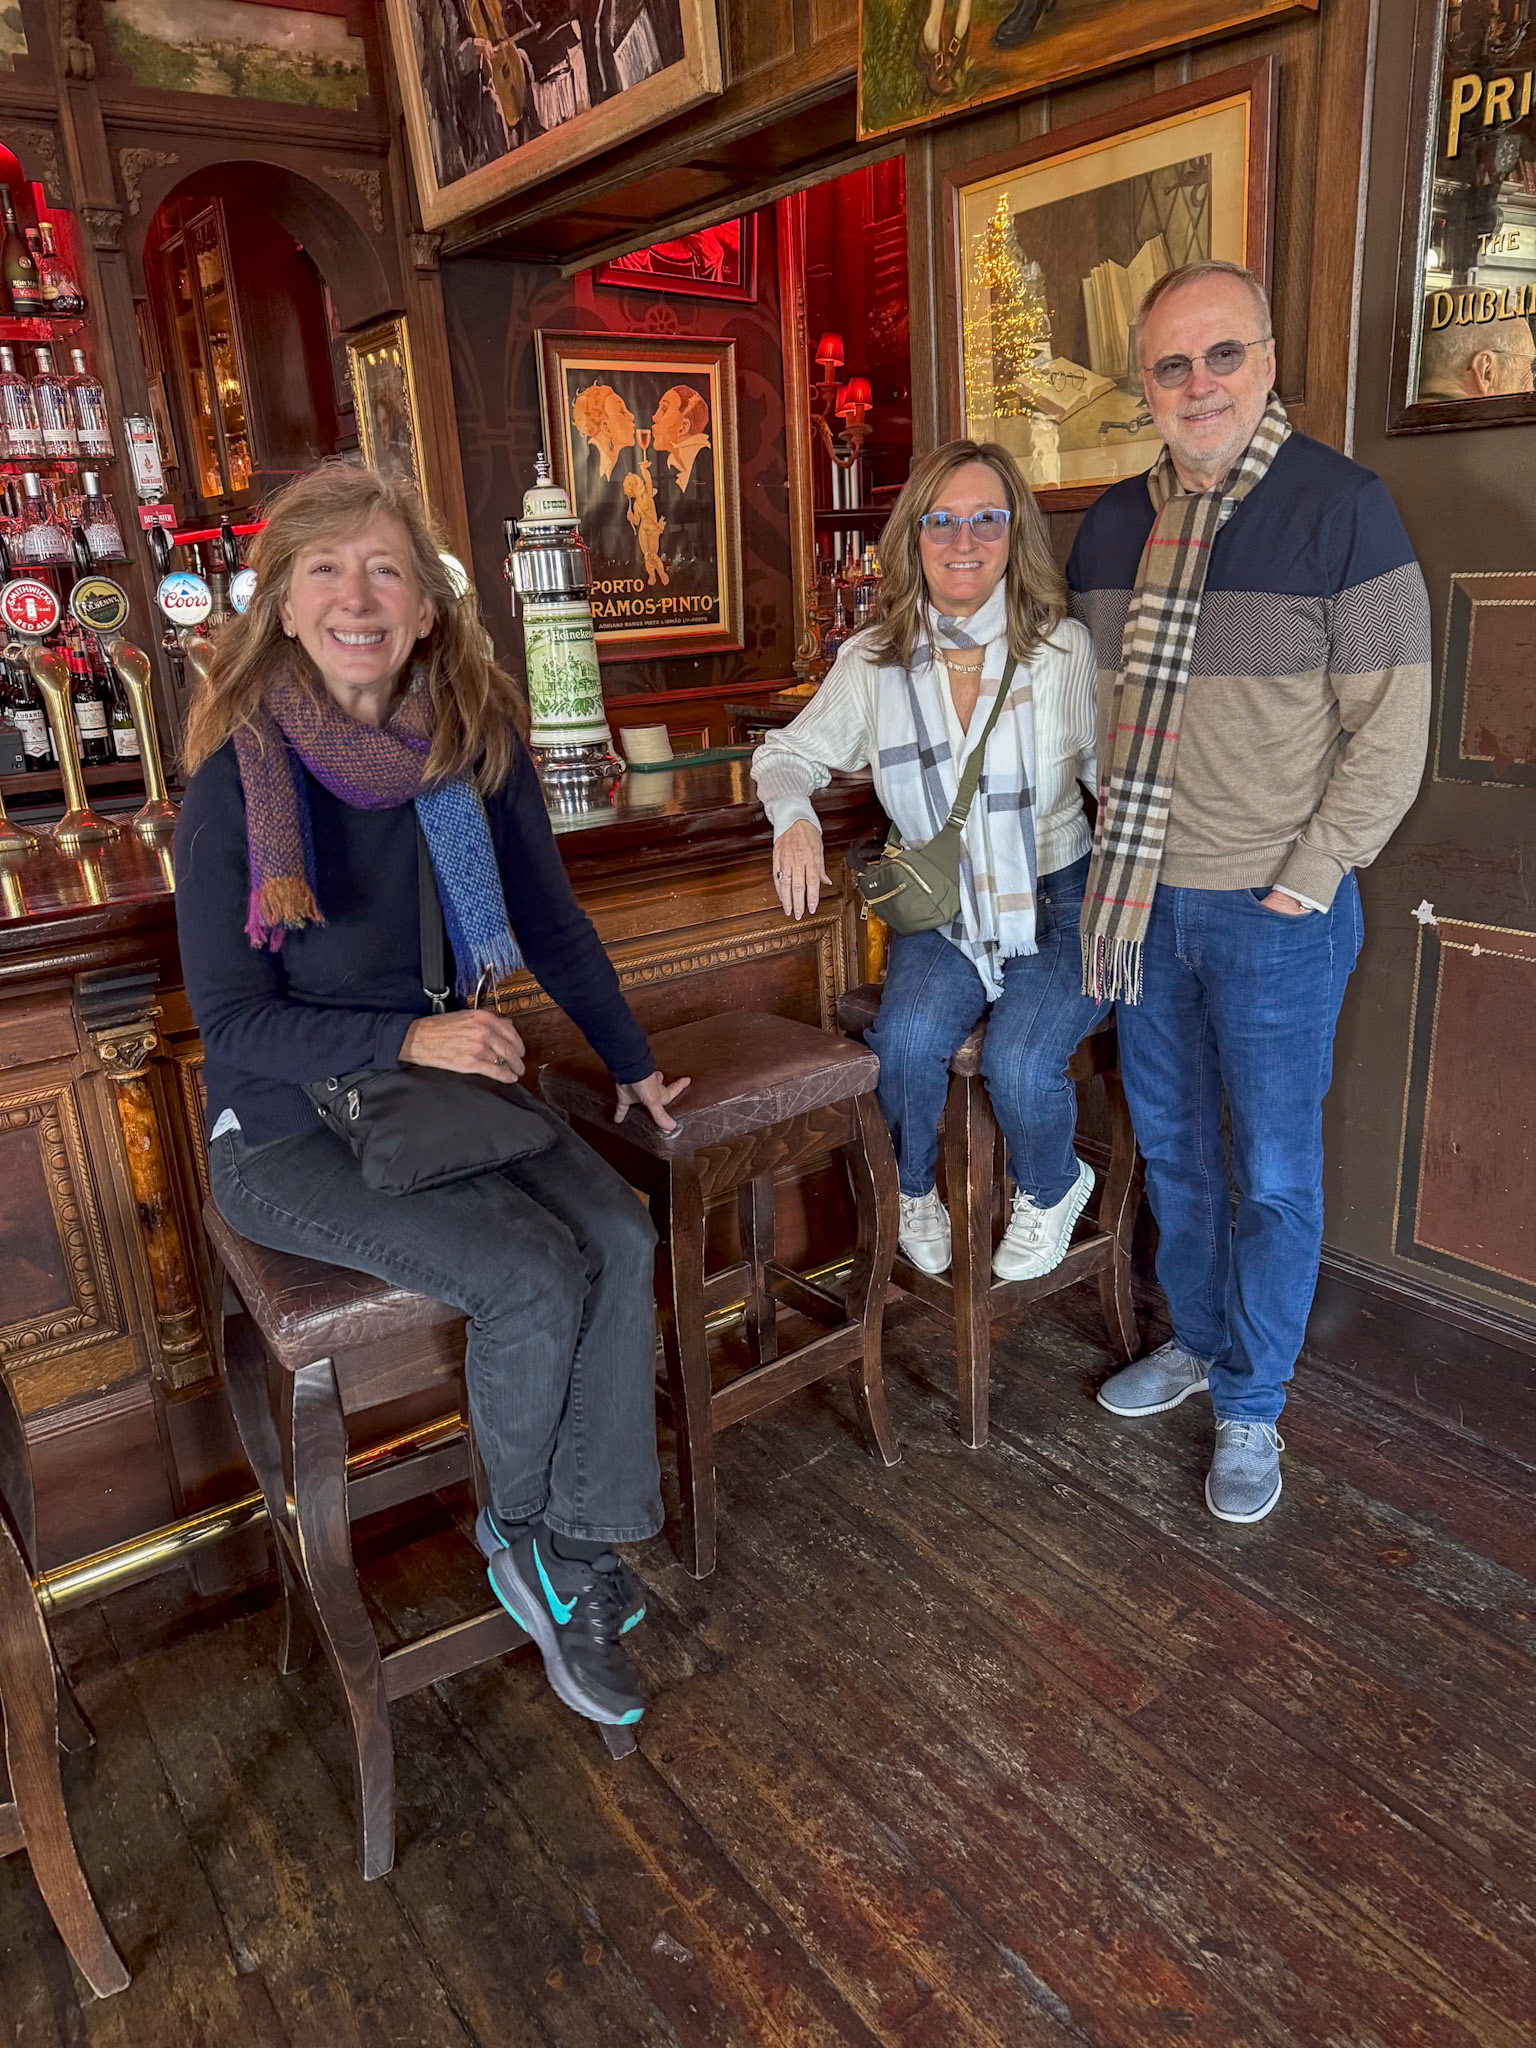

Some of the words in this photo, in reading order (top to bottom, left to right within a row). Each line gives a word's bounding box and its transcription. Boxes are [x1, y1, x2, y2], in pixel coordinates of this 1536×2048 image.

[1477, 231, 1520, 256] THE
[144, 514, 173, 524] BEEATER
[590, 578, 645, 595] PORTO
[164, 592, 208, 608] Coors
[16, 618, 35, 630] RED
[36, 618, 51, 630] ALE
[552, 628, 593, 641] Heineken
